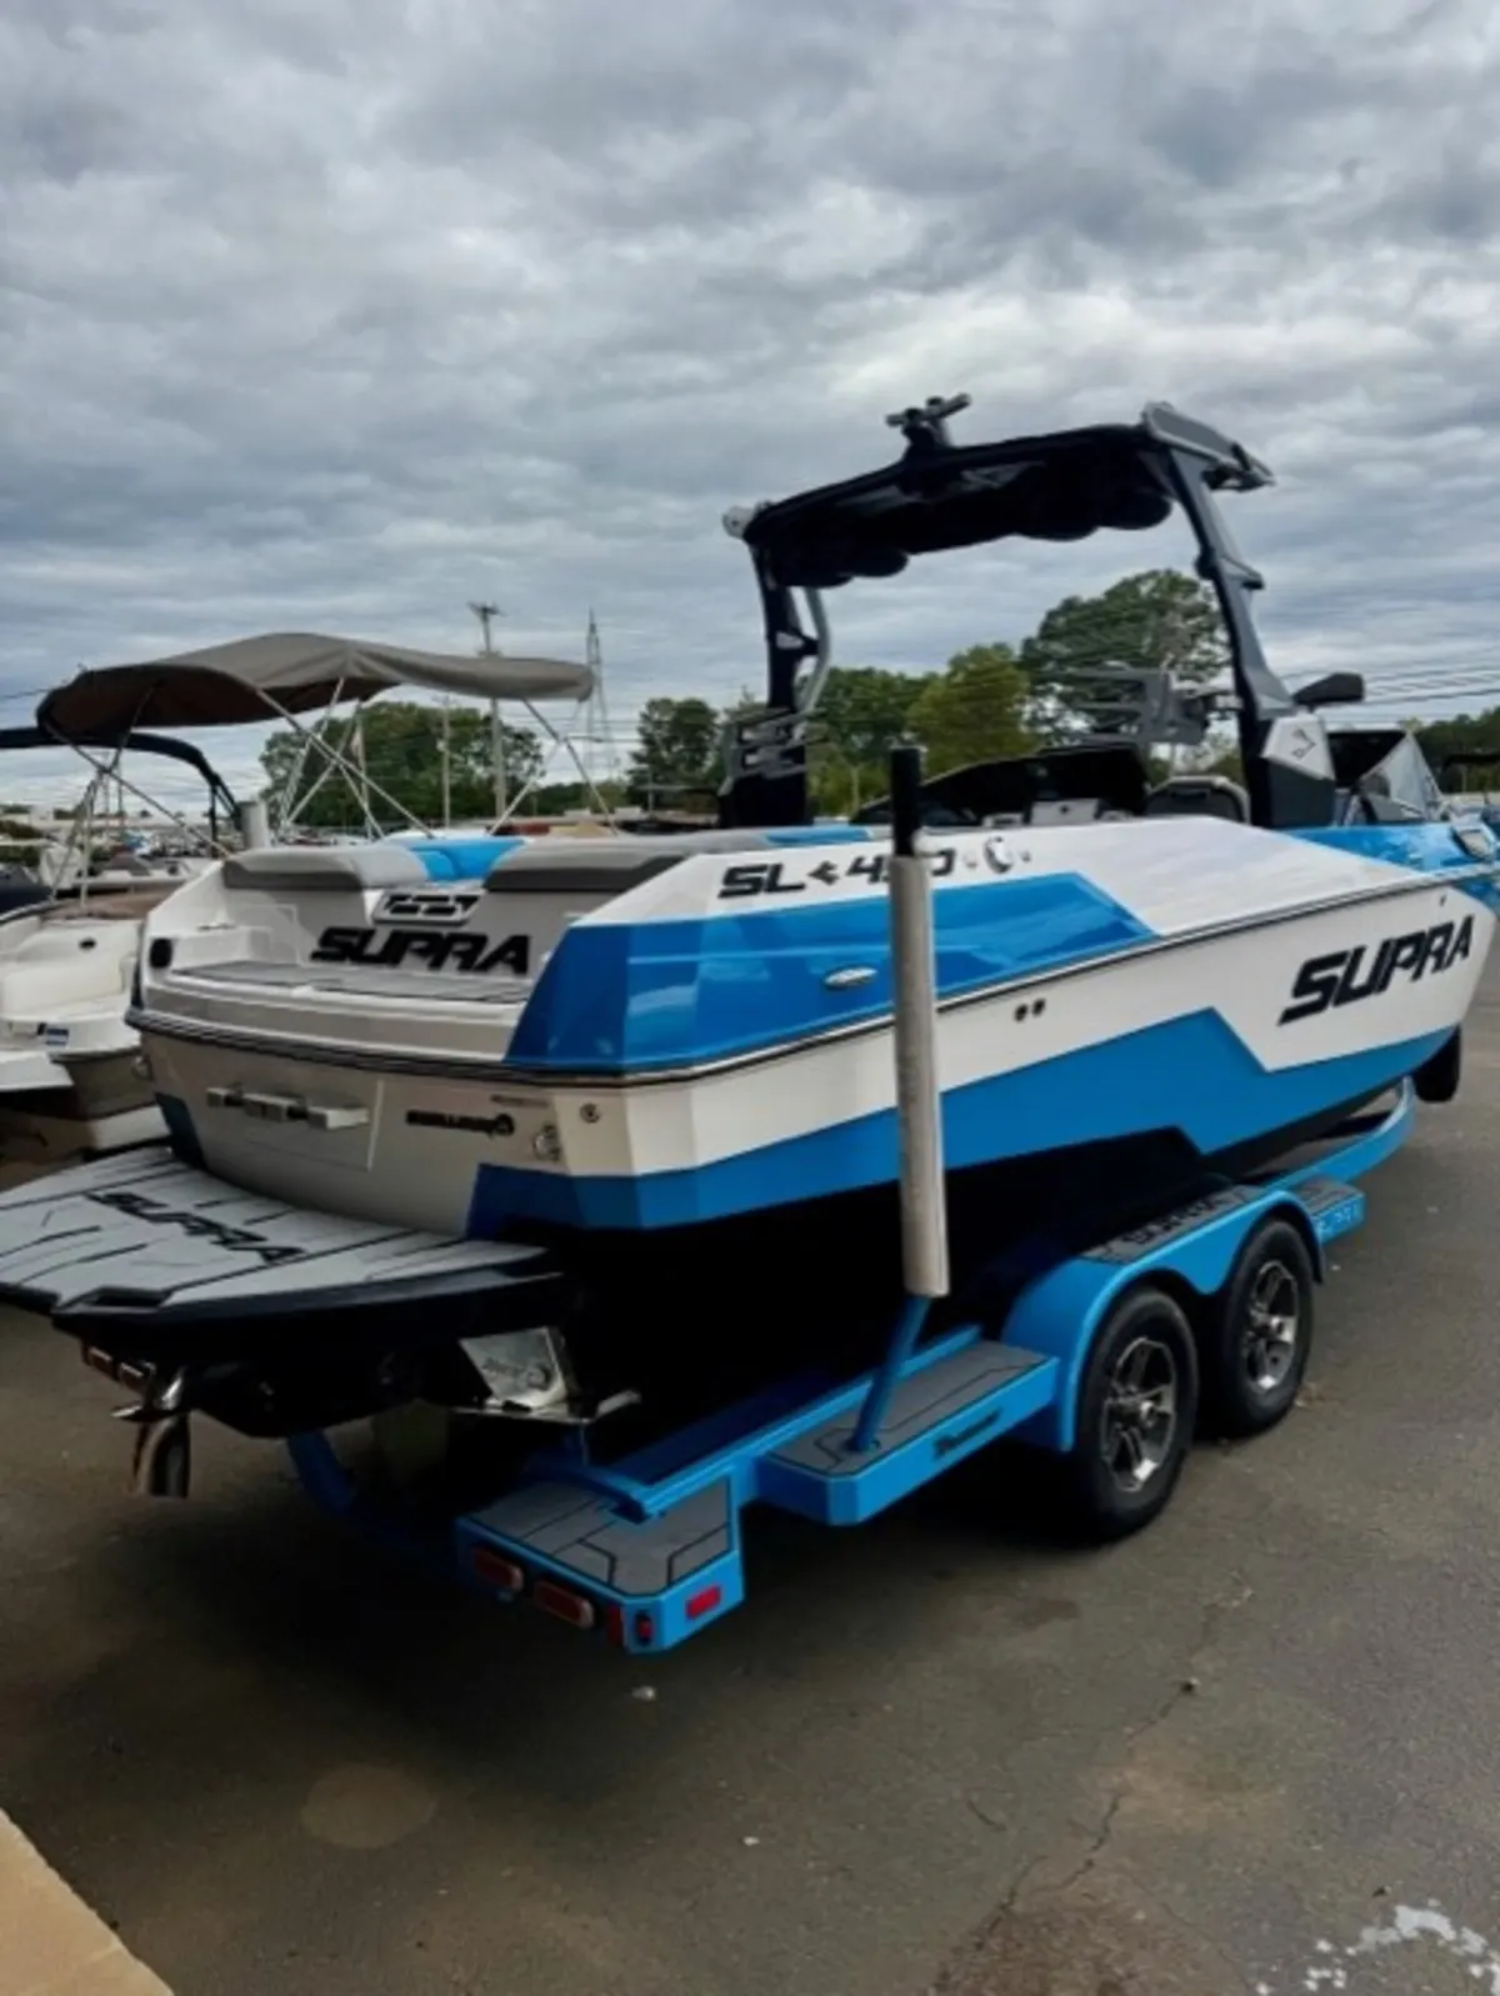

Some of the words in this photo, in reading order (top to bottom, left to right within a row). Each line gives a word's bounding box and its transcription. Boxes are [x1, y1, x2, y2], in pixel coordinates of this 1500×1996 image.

[718, 863, 806, 898] SL
[309, 926, 530, 976] SUPRA
[1277, 914, 1474, 1026] SUPRA
